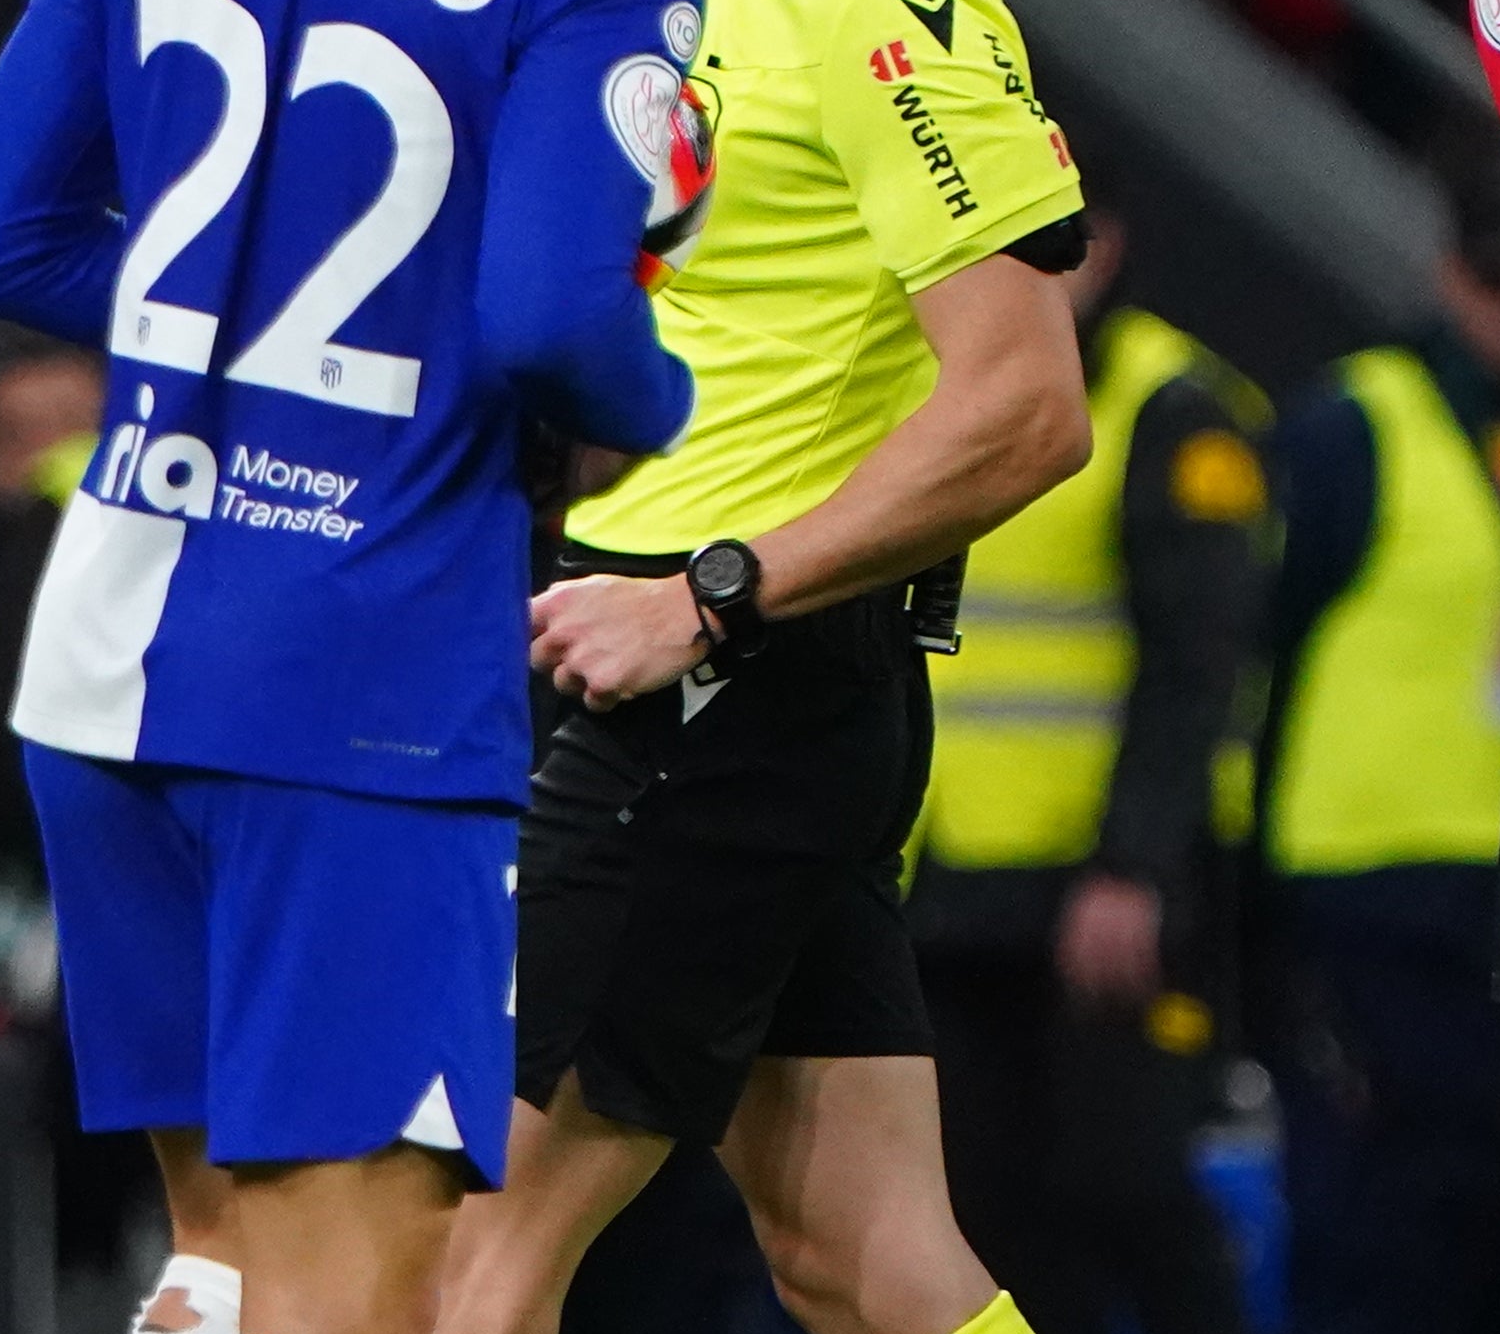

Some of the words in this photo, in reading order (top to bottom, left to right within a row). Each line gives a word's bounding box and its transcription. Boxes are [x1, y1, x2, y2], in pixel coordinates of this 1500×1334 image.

[892, 84, 979, 221] WÜRTH
[99, 382, 219, 520] ria
[231, 445, 359, 507] Money
[220, 484, 364, 542] Transfer
